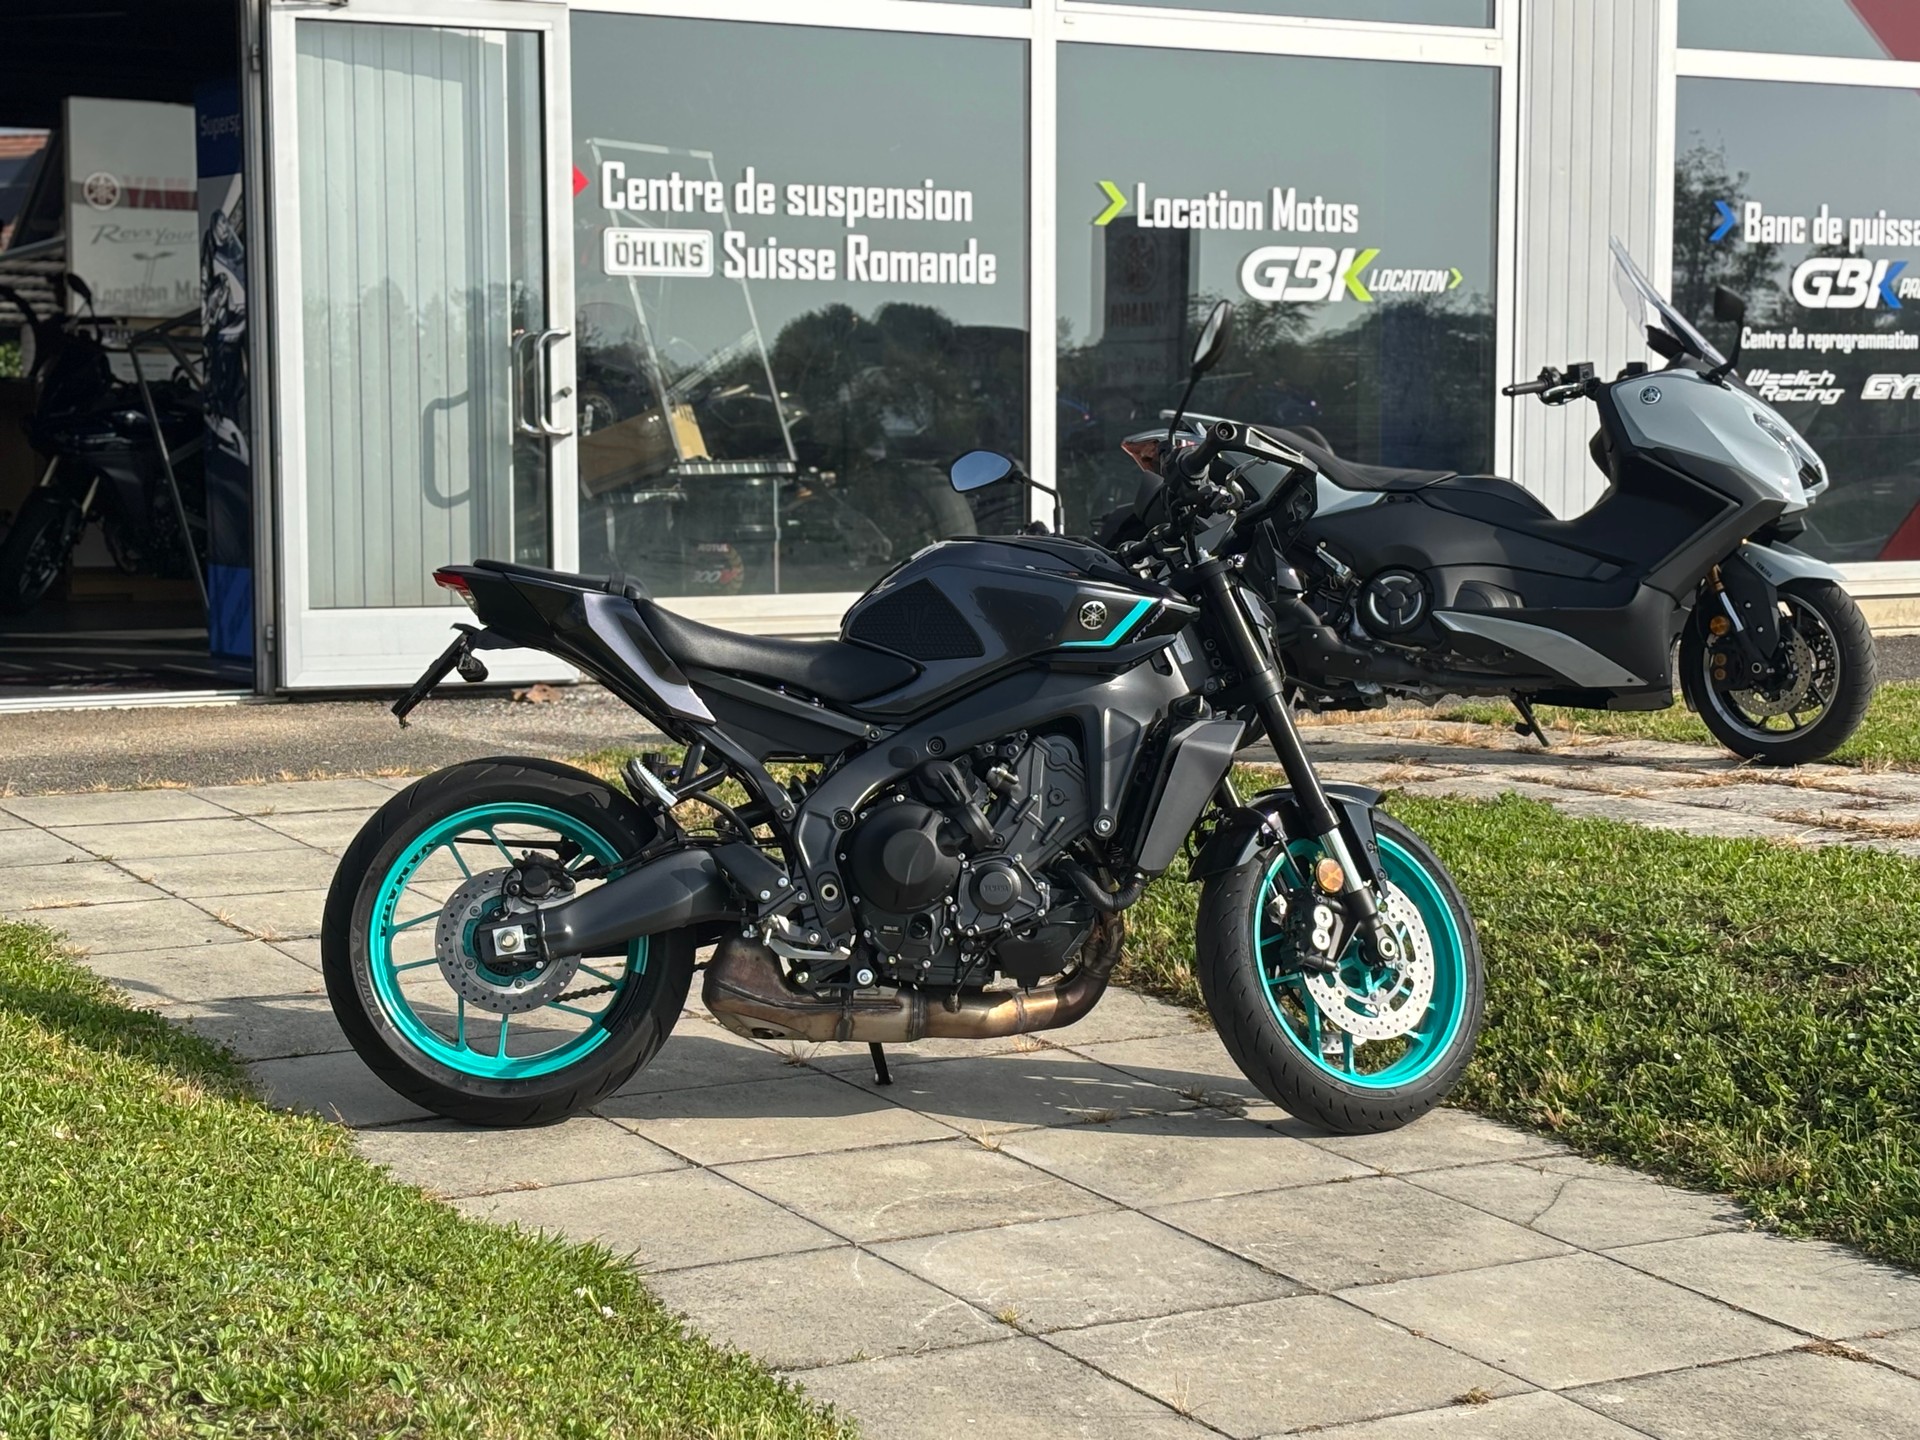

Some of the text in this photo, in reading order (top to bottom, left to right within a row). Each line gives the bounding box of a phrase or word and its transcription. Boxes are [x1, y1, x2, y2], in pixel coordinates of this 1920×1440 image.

[602, 160, 973, 228] Centre de suspension
[1136, 182, 1359, 233] Location Motos
[1744, 201, 1806, 244] Banc
[1812, 203, 1843, 246] de
[614, 230, 997, 285] ÖHLINS Suisse Romande
[1240, 245, 1449, 302] GBK LOCATION
[1792, 258, 1908, 309] GBK
[1740, 326, 1919, 355] Centre de reprogrammation
[1758, 386, 1845, 405] Racing
